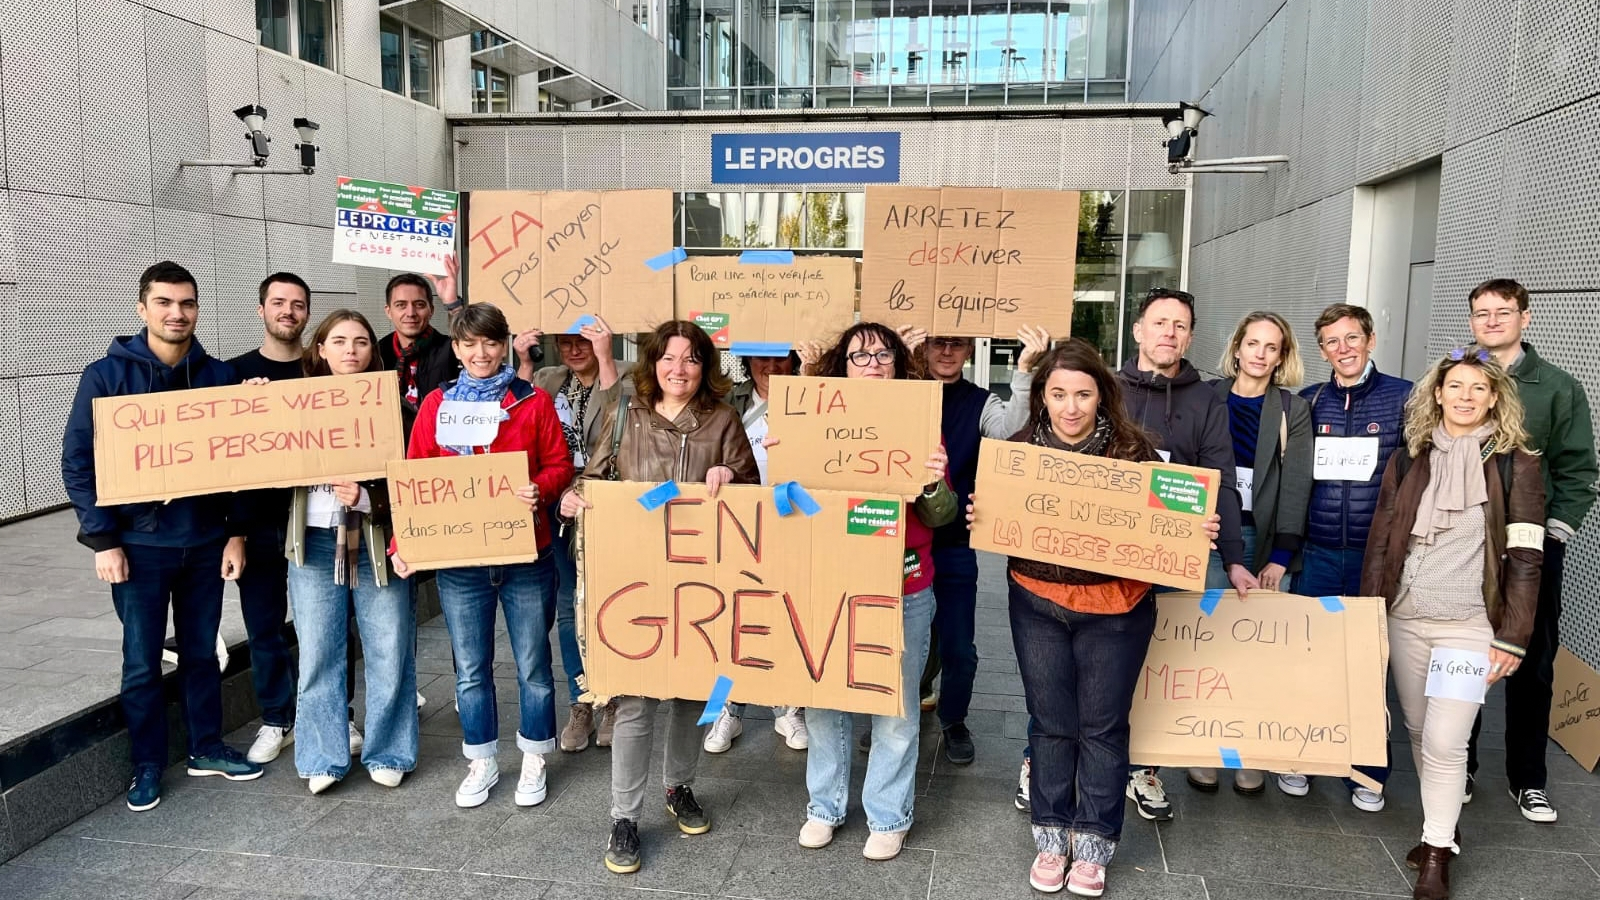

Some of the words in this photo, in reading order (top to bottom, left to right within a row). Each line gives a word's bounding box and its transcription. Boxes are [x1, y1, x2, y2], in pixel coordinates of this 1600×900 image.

[725, 147, 755, 170] LE
[761, 144, 885, 170] PROGRÈS
[340, 182, 377, 194] Informer
[884, 204, 1017, 231] ARRETEZ
[348, 242, 393, 255] CASSE
[370, 231, 404, 240] N'EST
[409, 234, 430, 243] PAS
[470, 210, 543, 270] IA
[501, 251, 540, 305] pas
[546, 203, 601, 252] moyen
[544, 236, 620, 319] Djadja
[752, 268, 775, 285] info
[712, 291, 733, 312] pas
[804, 288, 830, 308] IA)
[884, 279, 915, 311] les
[938, 286, 1021, 327] équipes
[177, 399, 227, 422] EST
[230, 396, 270, 417] DE
[439, 411, 457, 425] EN
[826, 426, 879, 440] nous
[134, 441, 194, 471] PLUS
[995, 447, 1026, 477] LE
[395, 477, 458, 507] MEPA
[1157, 475, 1172, 483] Pour
[1184, 480, 1205, 488] presse
[854, 504, 895, 516] Informer
[1175, 495, 1198, 504] qualité
[849, 516, 867, 524] c'est
[868, 517, 897, 528] résister
[1025, 493, 1060, 517] CE
[1070, 500, 1142, 529] N'EST
[1150, 513, 1193, 539] PAS
[401, 517, 438, 539] dans
[443, 521, 473, 536] nos
[483, 518, 528, 546] pages
[664, 498, 764, 565] EN
[993, 517, 1023, 548] LA
[1032, 526, 1111, 563] CASSE
[1518, 529, 1537, 544] EN
[596, 569, 900, 695] GRÈVE
[1231, 618, 1289, 646] OUI
[1144, 663, 1233, 700] MEPA
[1430, 659, 1443, 673] EN
[1446, 660, 1485, 677] GRÈVE
[1258, 720, 1347, 757] moyens
